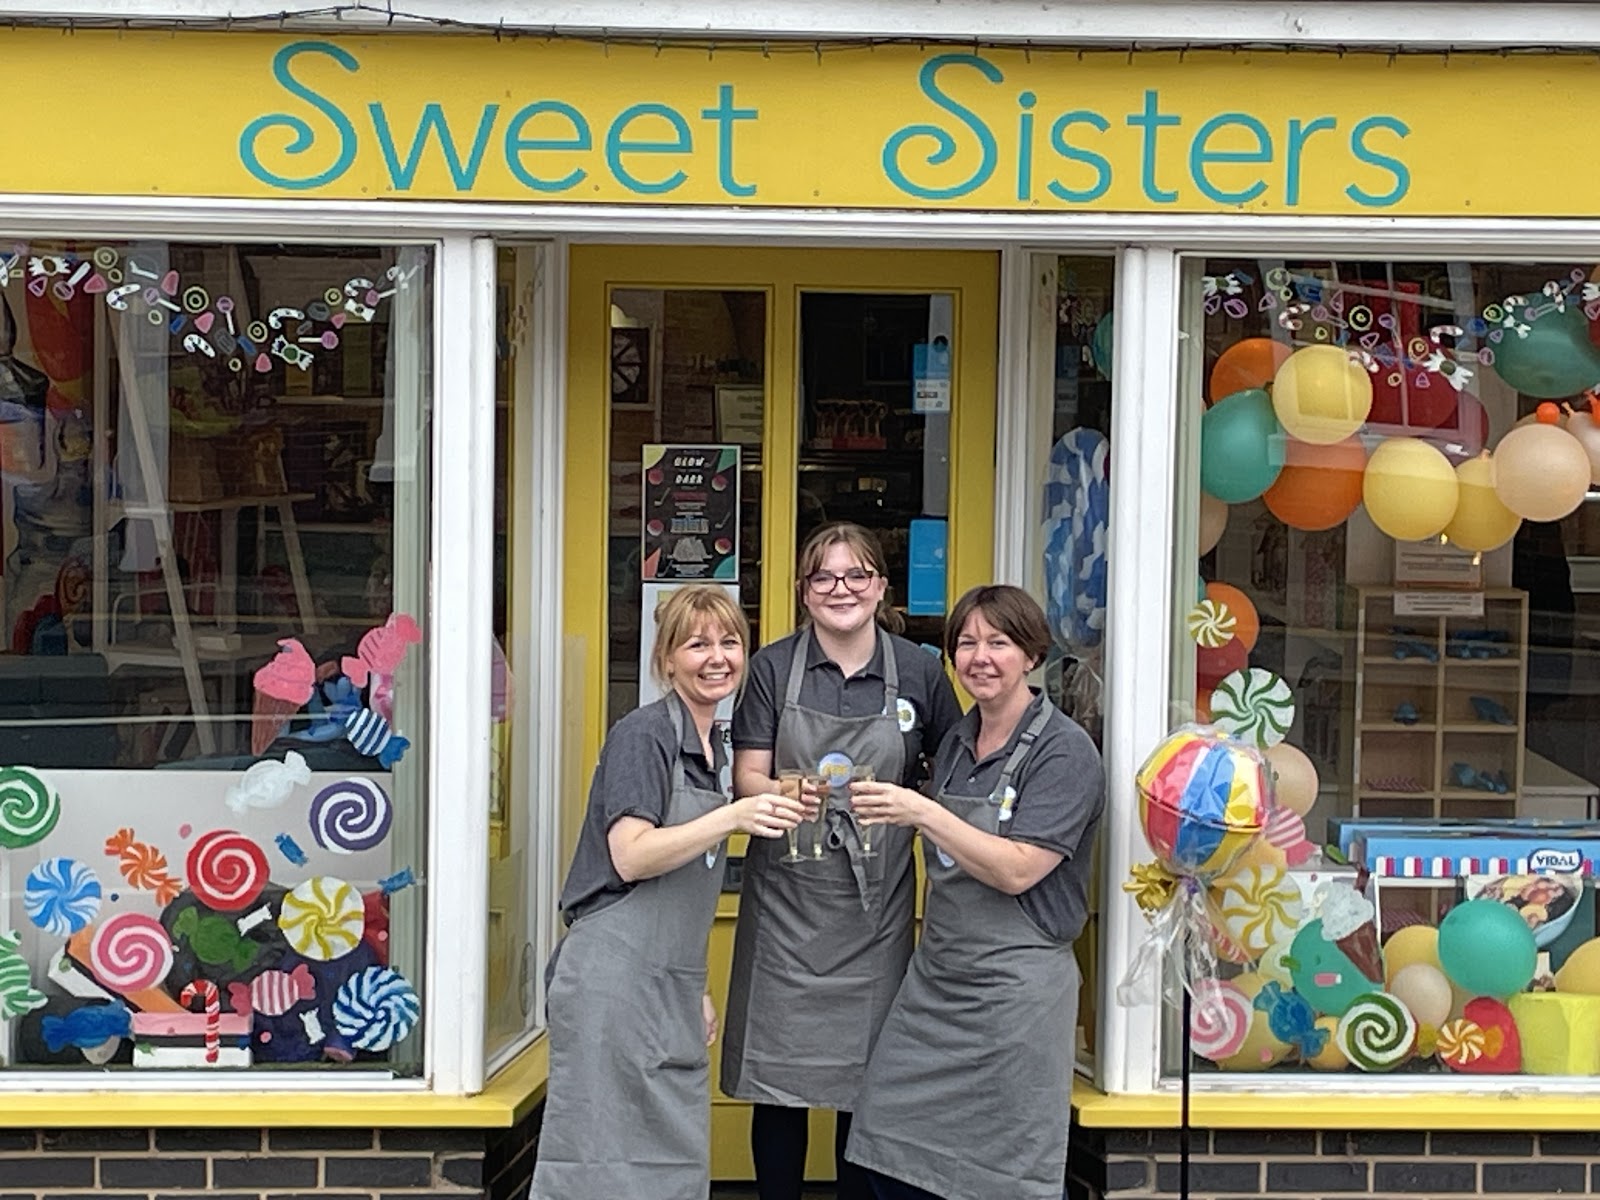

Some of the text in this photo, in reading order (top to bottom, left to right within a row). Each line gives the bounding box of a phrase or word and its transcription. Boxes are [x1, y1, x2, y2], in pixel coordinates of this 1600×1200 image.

[239, 41, 1411, 207] Sweet Sisters
[1536, 855, 1576, 866] VIDAL
